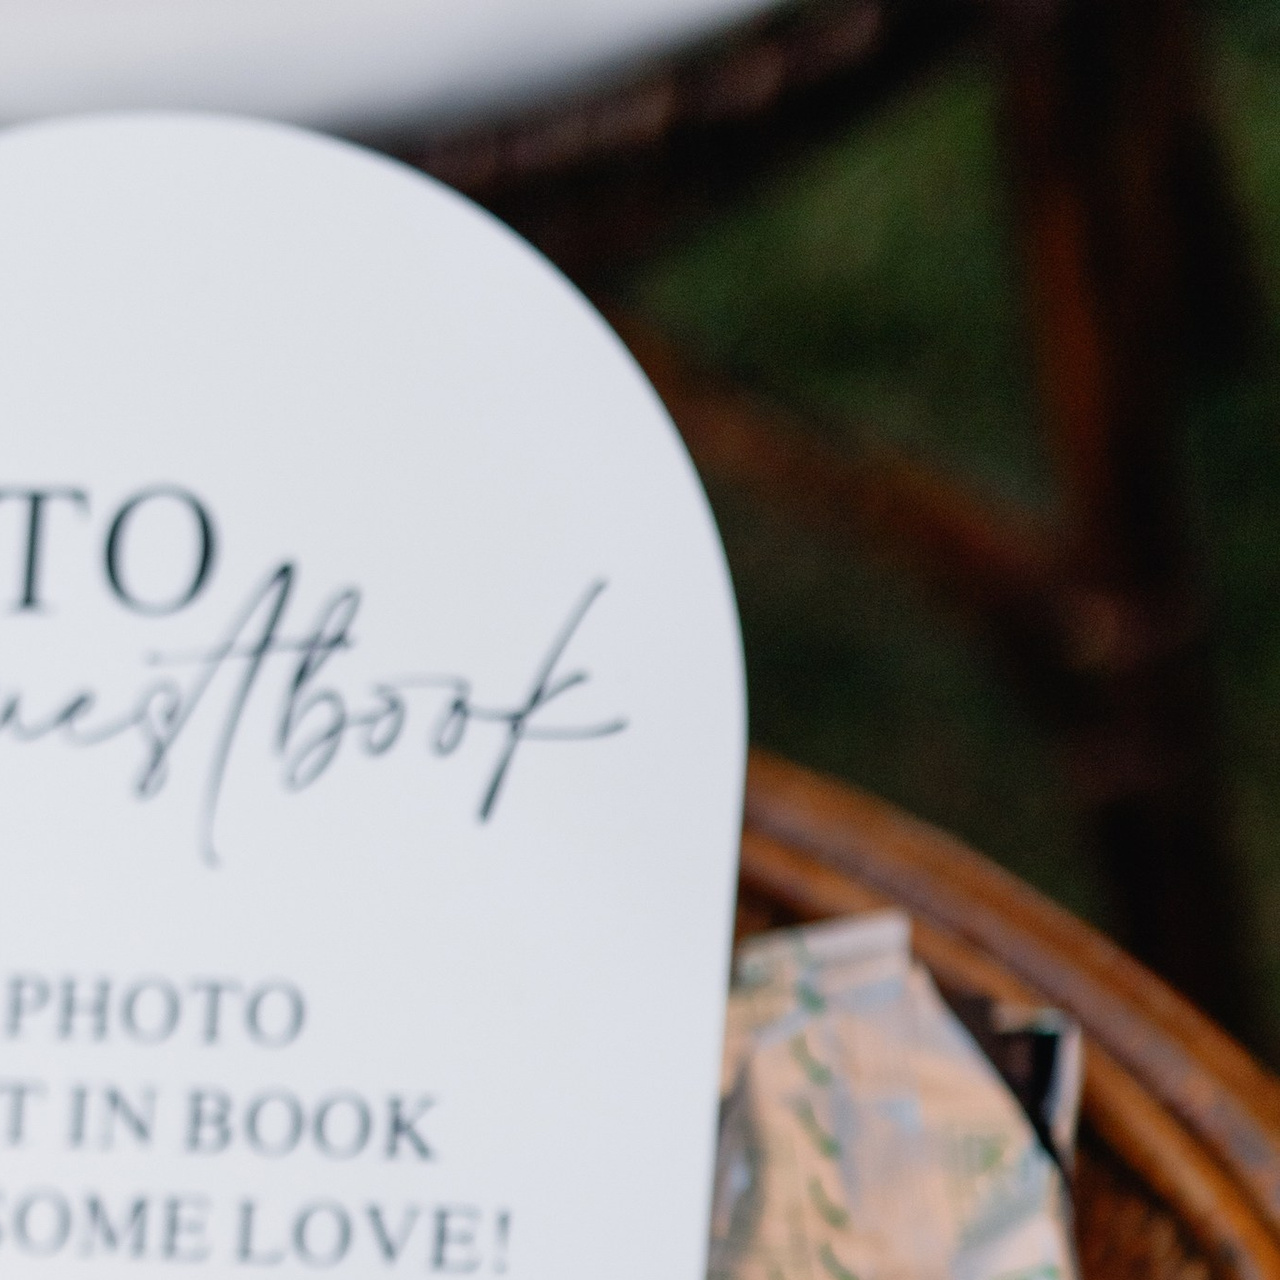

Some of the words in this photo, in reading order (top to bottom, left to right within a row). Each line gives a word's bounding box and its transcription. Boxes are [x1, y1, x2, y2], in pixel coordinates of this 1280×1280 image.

[3, 972, 309, 1047] PHOTO
[67, 1083, 157, 1150] IN
[183, 1086, 436, 1163] BOOK
[235, 1197, 512, 1274] LOVE!
